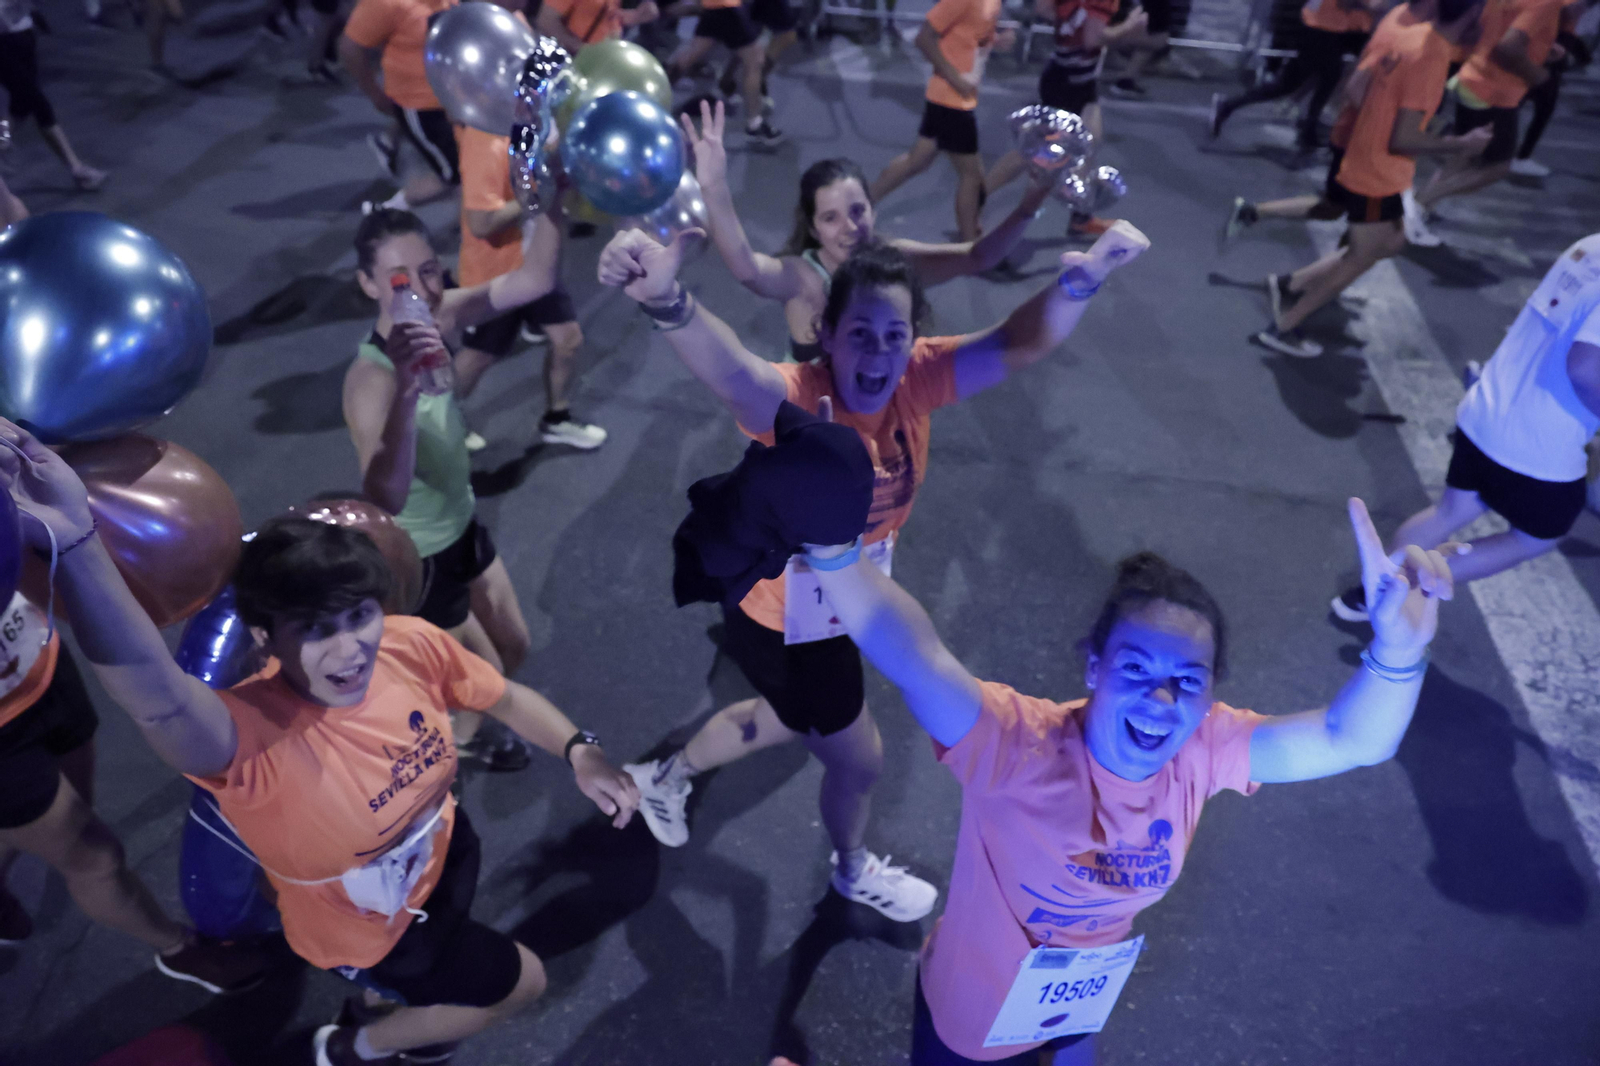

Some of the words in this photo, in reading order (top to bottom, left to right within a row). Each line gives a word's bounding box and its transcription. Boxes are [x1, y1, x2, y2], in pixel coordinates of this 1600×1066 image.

[369, 764, 424, 813] SEVILLA
[1064, 864, 1131, 888] SEVILLA
[1038, 975, 1108, 1004] 19509
